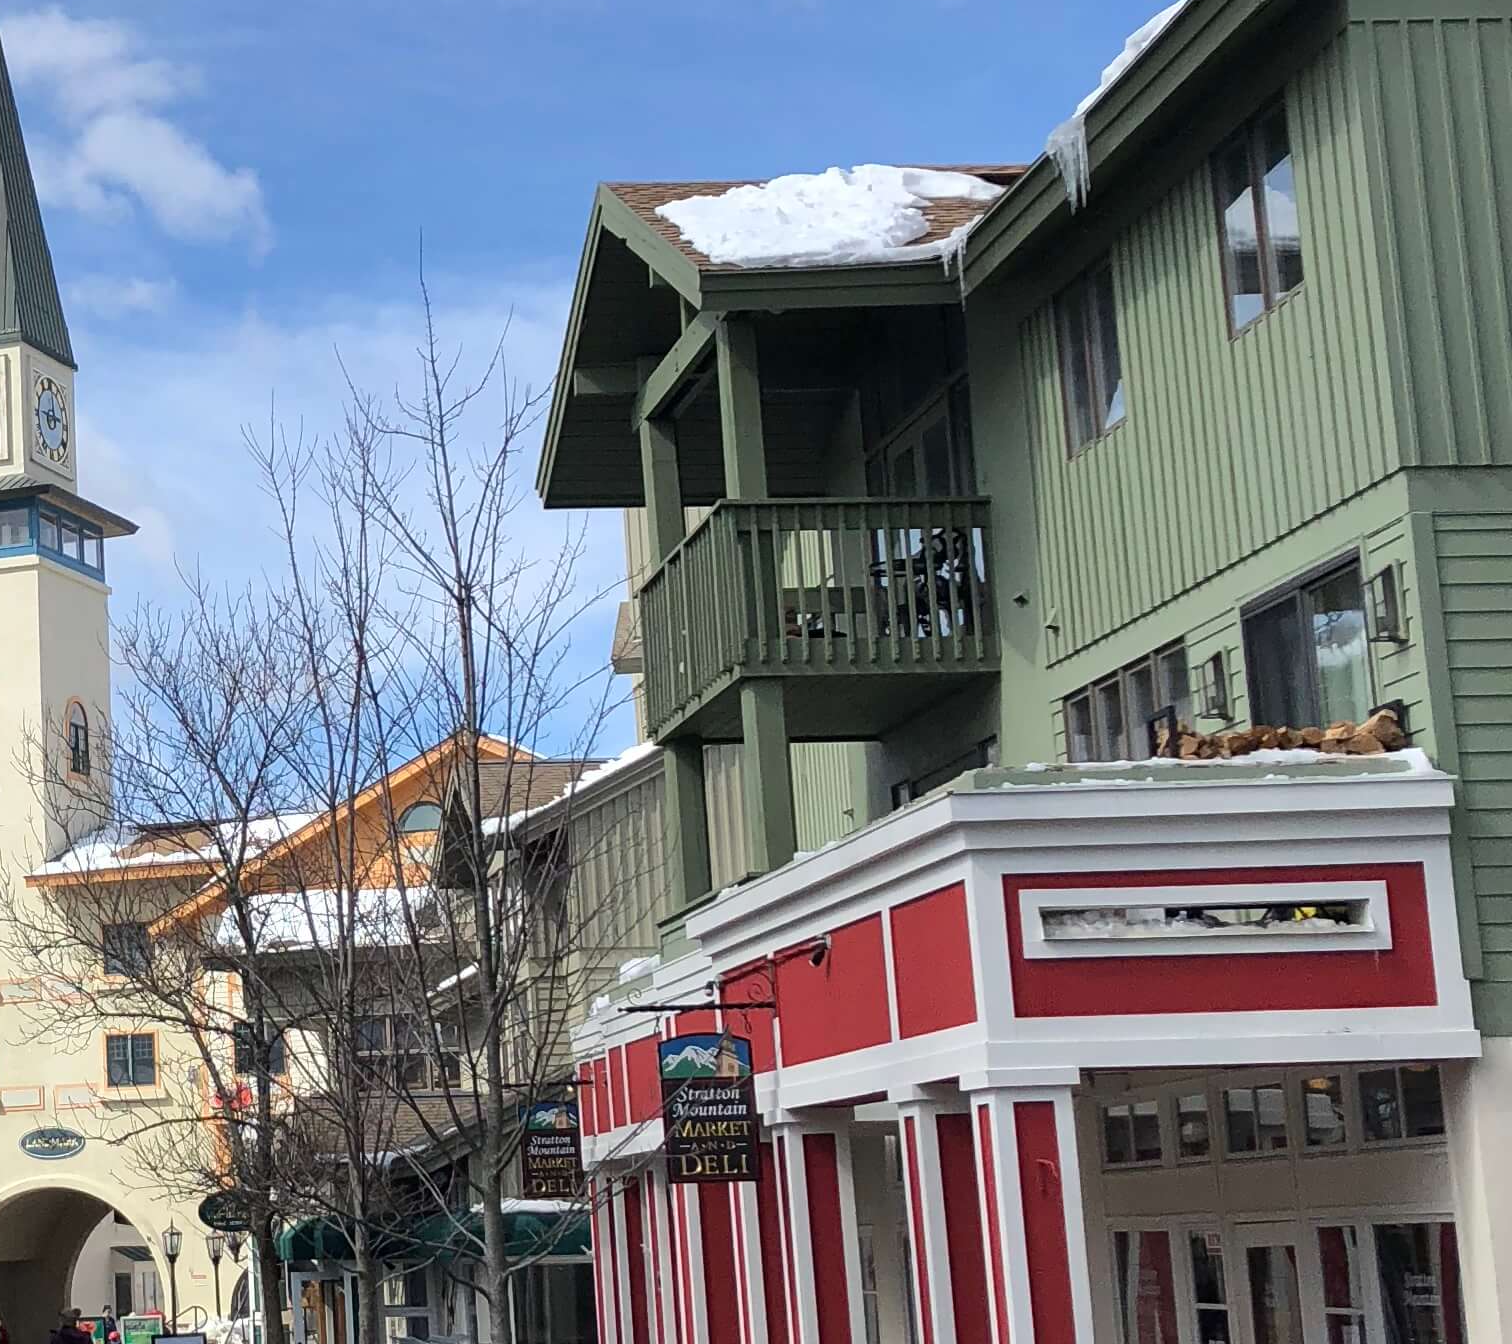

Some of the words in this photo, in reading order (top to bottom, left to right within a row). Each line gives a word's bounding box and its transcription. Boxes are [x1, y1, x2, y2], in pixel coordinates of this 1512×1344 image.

[676, 1086, 740, 1102] Stratton
[672, 1101, 747, 1118] Mountain
[675, 1120, 751, 1138] MARKET
[530, 1136, 571, 1146] Stratton
[527, 1146, 575, 1156] Mountain
[528, 1157, 577, 1169] MARKET
[680, 1154, 749, 1175] DELI
